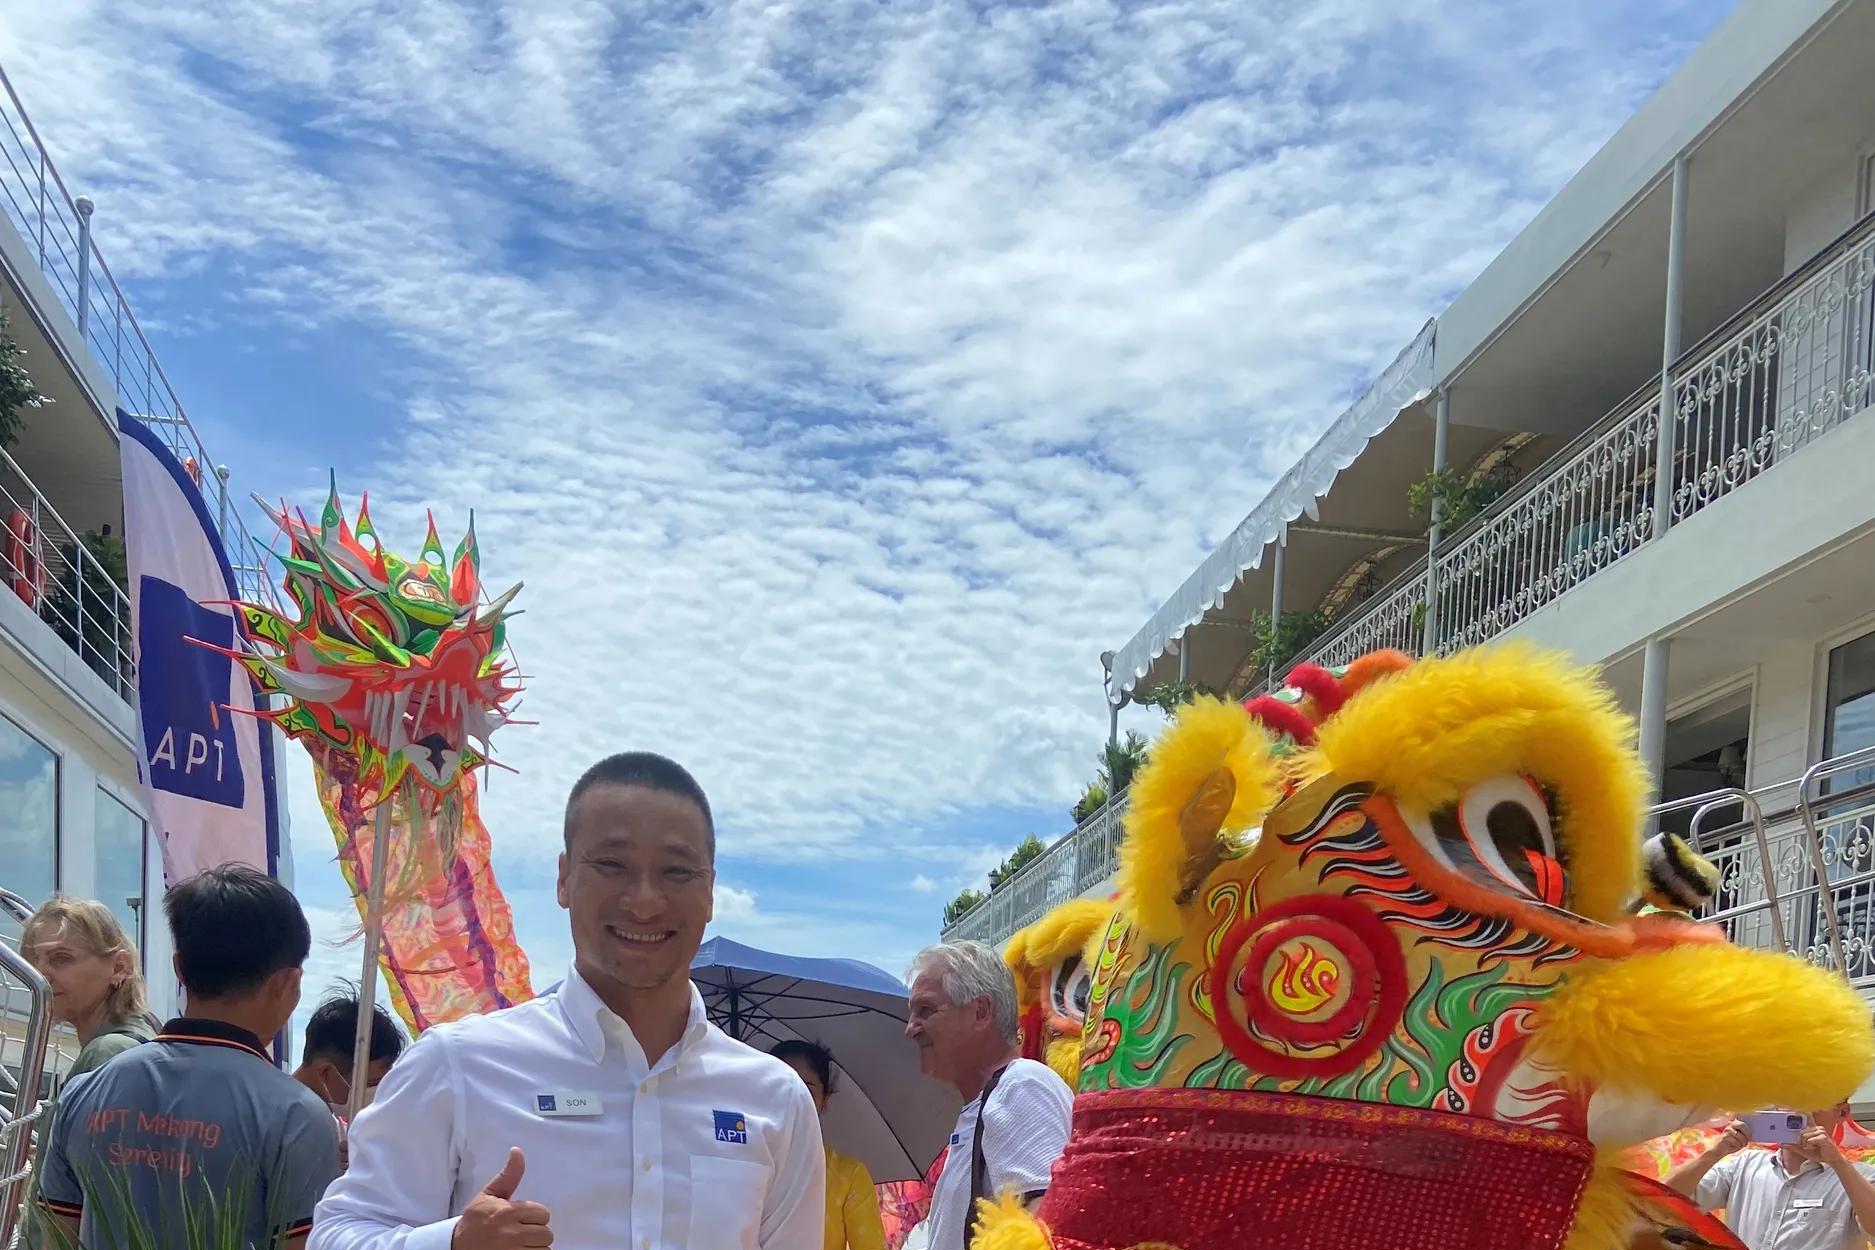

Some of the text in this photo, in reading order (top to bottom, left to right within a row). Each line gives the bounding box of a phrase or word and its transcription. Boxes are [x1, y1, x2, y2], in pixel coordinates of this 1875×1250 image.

[150, 726, 224, 782] APT
[566, 1099, 587, 1107] SON
[88, 1108, 221, 1148] APT Mekong
[717, 1128, 746, 1143] APT
